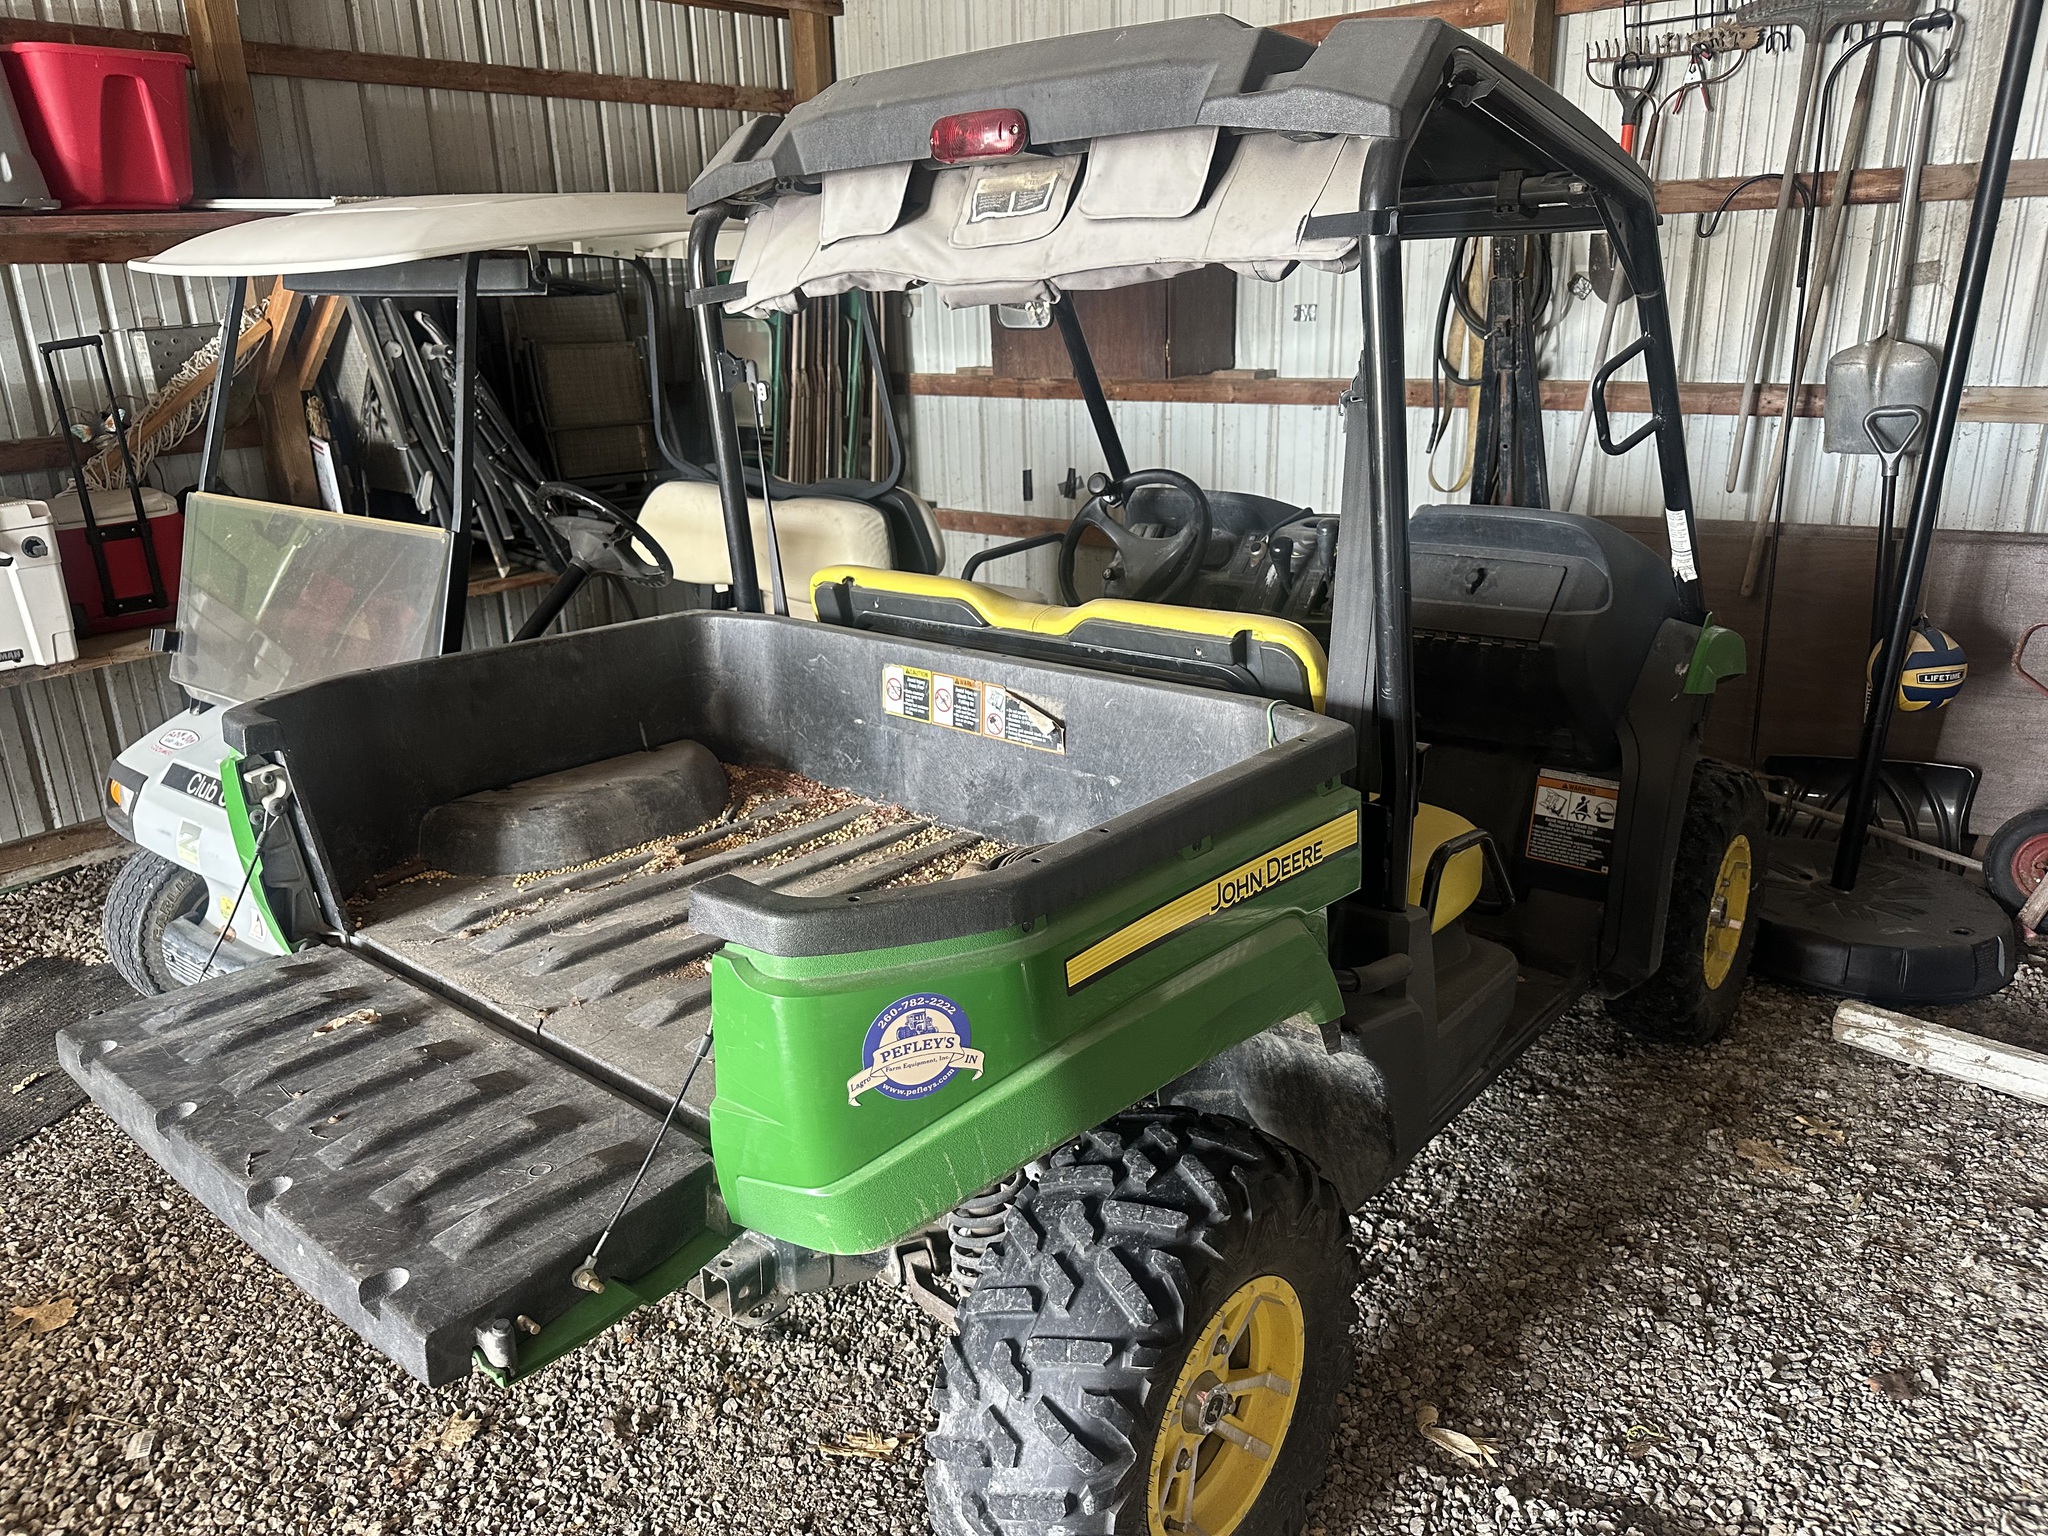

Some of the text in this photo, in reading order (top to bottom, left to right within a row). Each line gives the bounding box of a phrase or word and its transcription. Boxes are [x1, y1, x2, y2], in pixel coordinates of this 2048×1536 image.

[909, 668, 928, 678] CAUTION
[1924, 672, 1961, 682] LIFETIME
[187, 773, 218, 802] Club
[1569, 783, 1596, 795] WARNING
[1210, 840, 1323, 913] JOHN DEERE
[877, 996, 957, 1029] 260-782-2222
[880, 1036, 955, 1064] PEFLEY'S
[885, 1054, 951, 1073] Farm Equipment, Inc.
[850, 1054, 978, 1092] Lagro IN
[882, 1068, 955, 1097] www.pefleys.com
